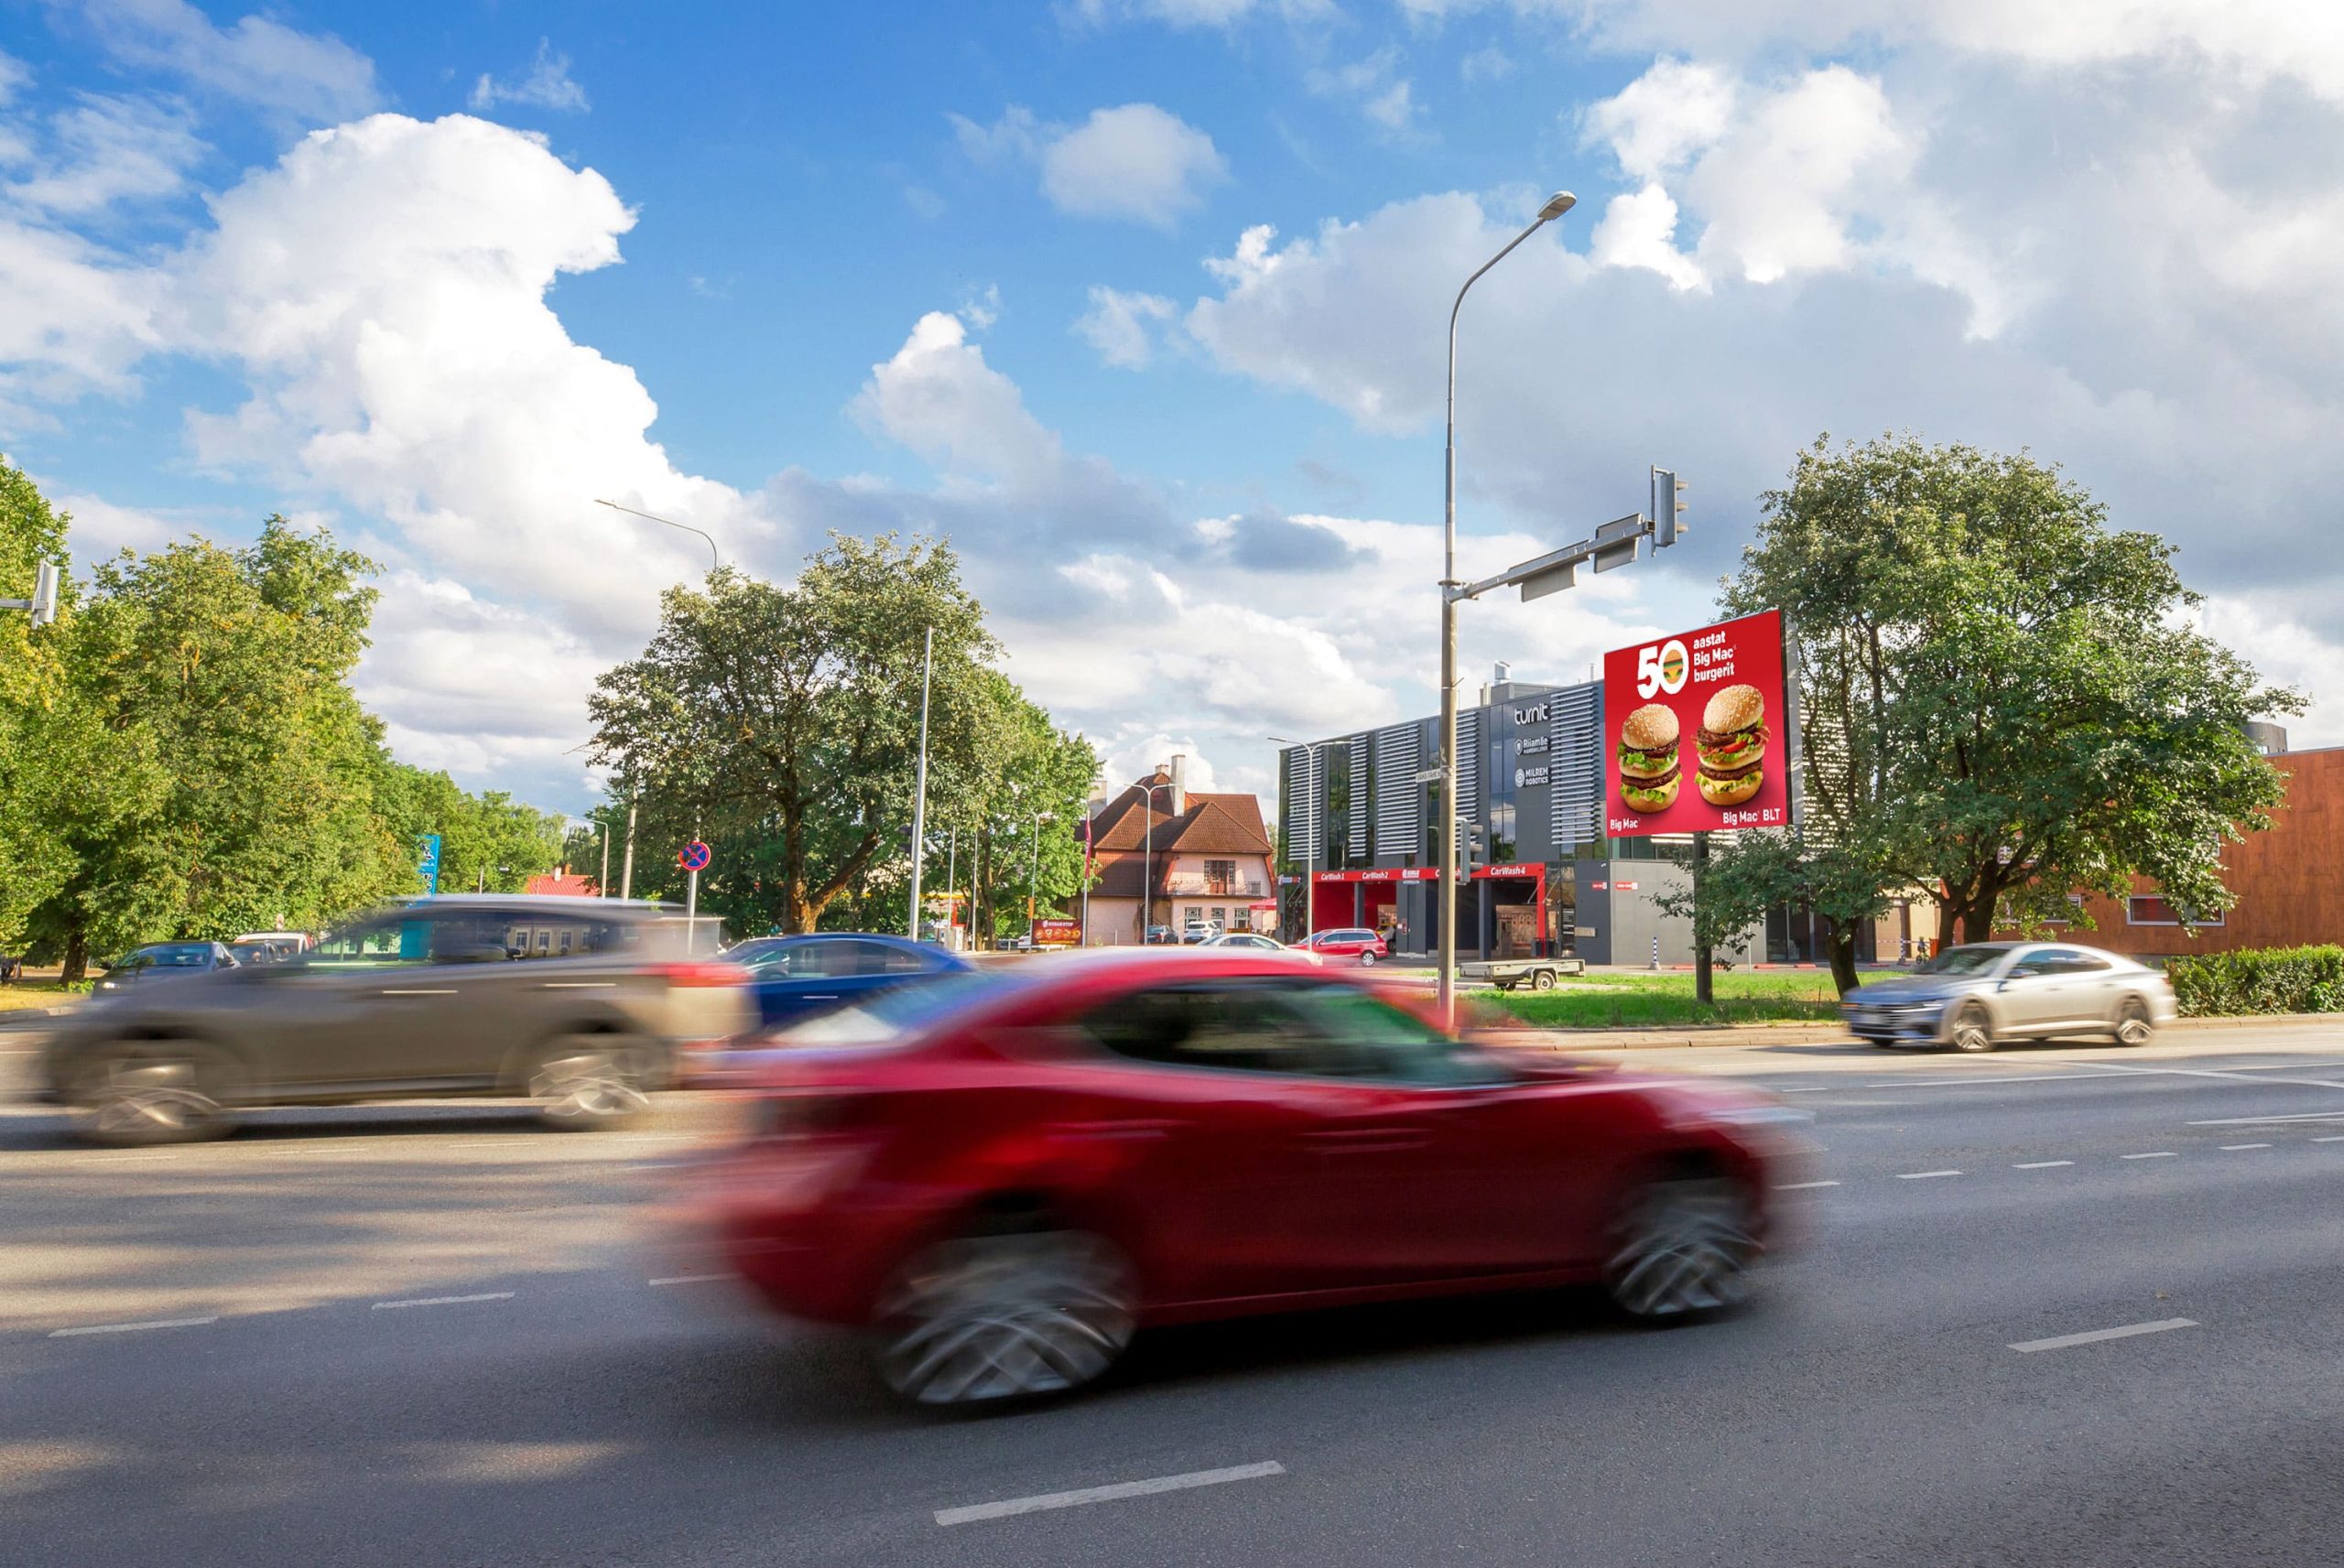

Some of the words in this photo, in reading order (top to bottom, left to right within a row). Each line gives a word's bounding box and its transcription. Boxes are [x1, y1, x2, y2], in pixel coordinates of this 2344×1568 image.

[1693, 631, 1726, 649] aastat
[1693, 651, 1710, 666] Big
[1712, 648, 1734, 662] Mac
[1637, 640, 1689, 699] 50
[1694, 662, 1734, 683] burgerit
[1514, 703, 1548, 725] turnit
[1525, 767, 1548, 778] MILREM
[1610, 818, 1622, 831] Big
[1722, 812, 1737, 826] Big
[1763, 808, 1781, 821] BLT
